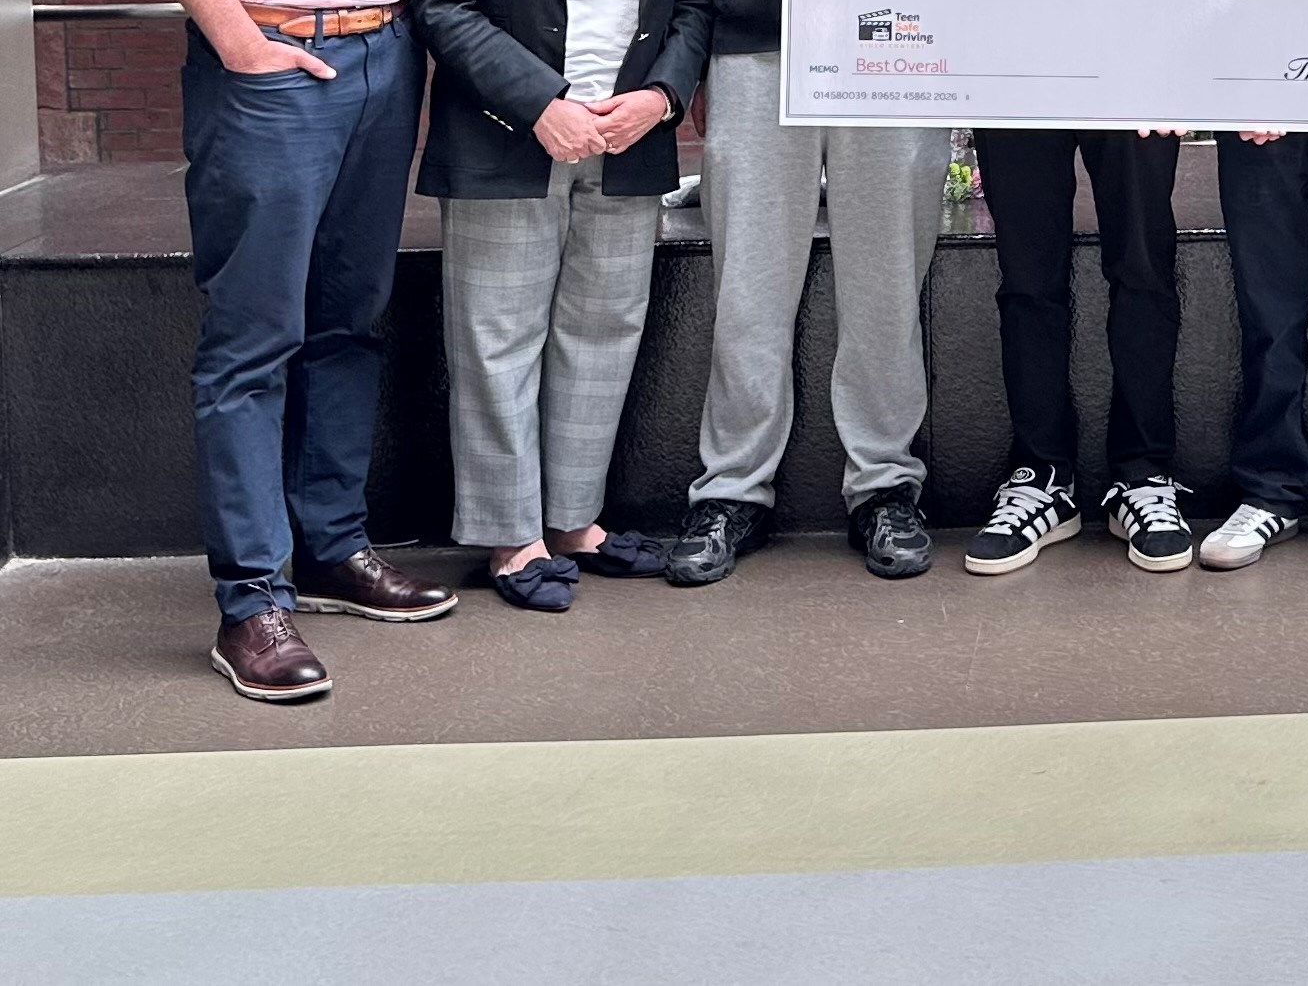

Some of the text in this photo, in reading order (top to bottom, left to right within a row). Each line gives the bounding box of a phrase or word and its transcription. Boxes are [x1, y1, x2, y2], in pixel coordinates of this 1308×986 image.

[895, 12, 920, 22] Teen
[895, 22, 919, 32] Safe
[895, 31, 934, 45] Driving
[809, 65, 839, 74] MEMO
[856, 58, 949, 74] Best Overall
